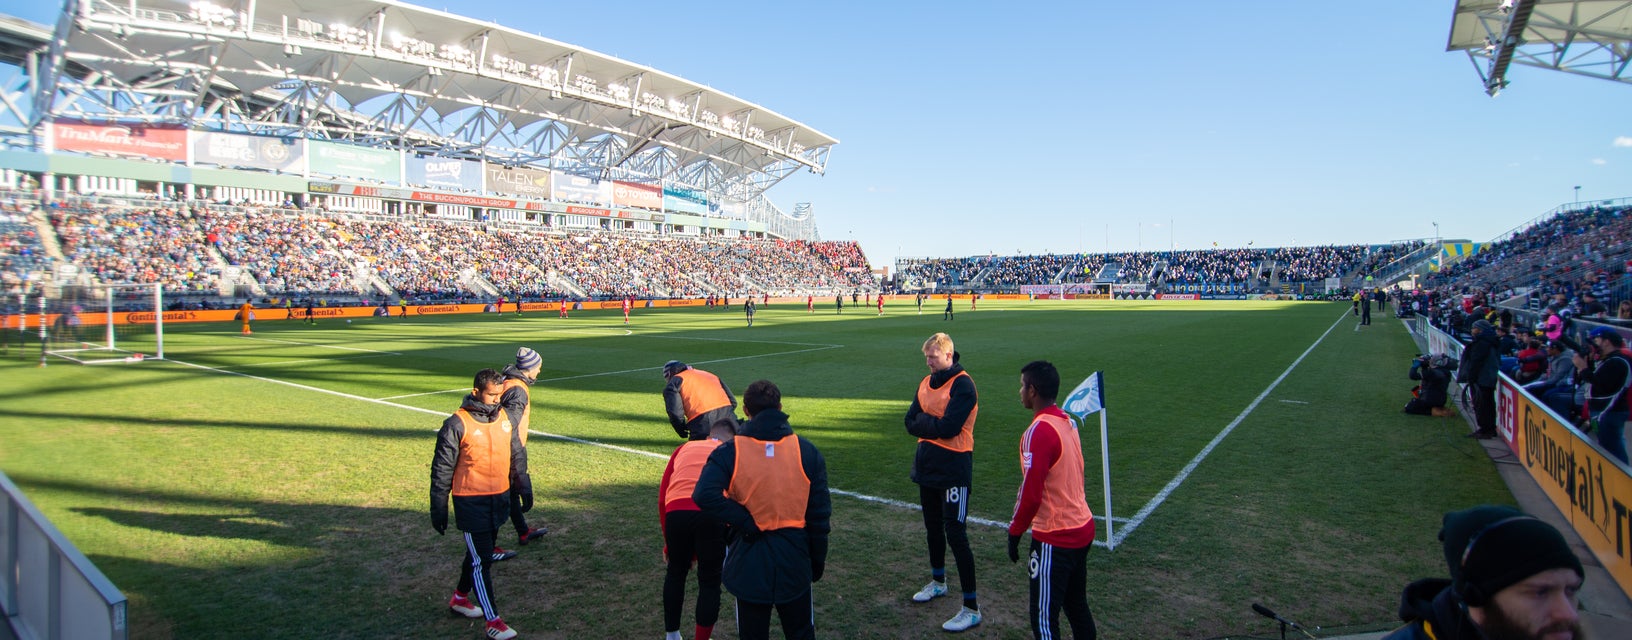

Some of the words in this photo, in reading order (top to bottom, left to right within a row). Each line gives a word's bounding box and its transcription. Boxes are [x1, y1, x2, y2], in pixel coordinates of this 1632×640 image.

[58, 126, 132, 145] TruMark
[490, 169, 533, 186] TALEN
[515, 185, 545, 195] ENERGY
[628, 190, 660, 200] TOYOTA
[419, 192, 433, 201] THE
[489, 199, 510, 208] GROUP
[417, 305, 454, 315] Continental
[1498, 392, 1513, 434] RE
[1525, 403, 1595, 523] Coninental
[1613, 496, 1632, 567] T
[946, 486, 959, 503] 18
[1027, 557, 1039, 579] 9
